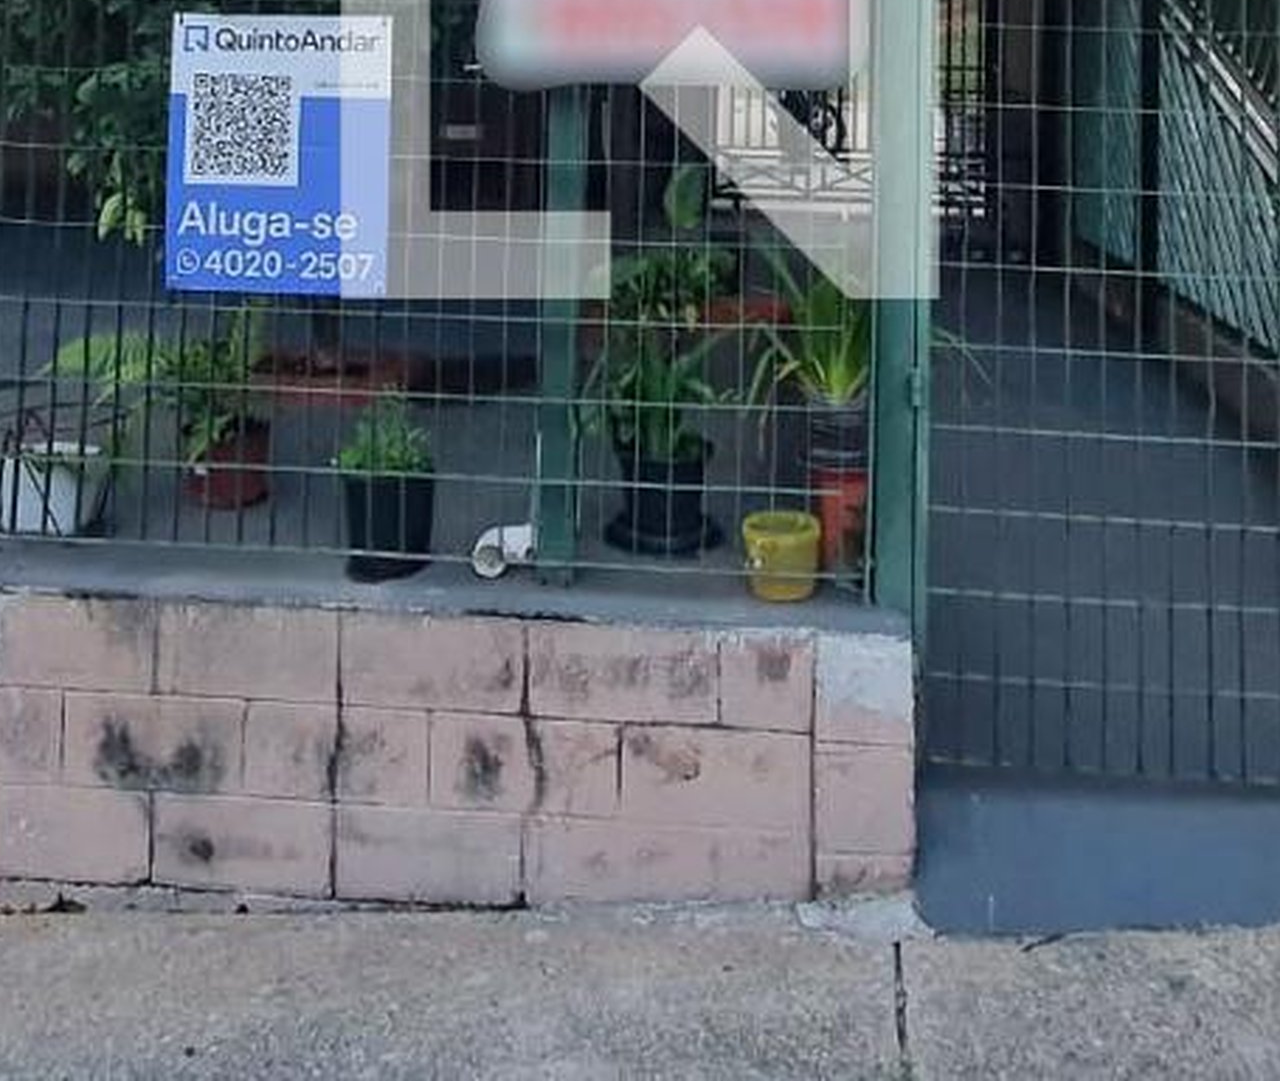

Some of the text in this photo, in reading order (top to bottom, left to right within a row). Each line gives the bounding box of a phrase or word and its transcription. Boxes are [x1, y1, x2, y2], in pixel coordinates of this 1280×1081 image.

[215, 27, 380, 53] QuintoAndar
[176, 201, 358, 246] Aluga-se
[203, 250, 374, 280] 4020-2507
